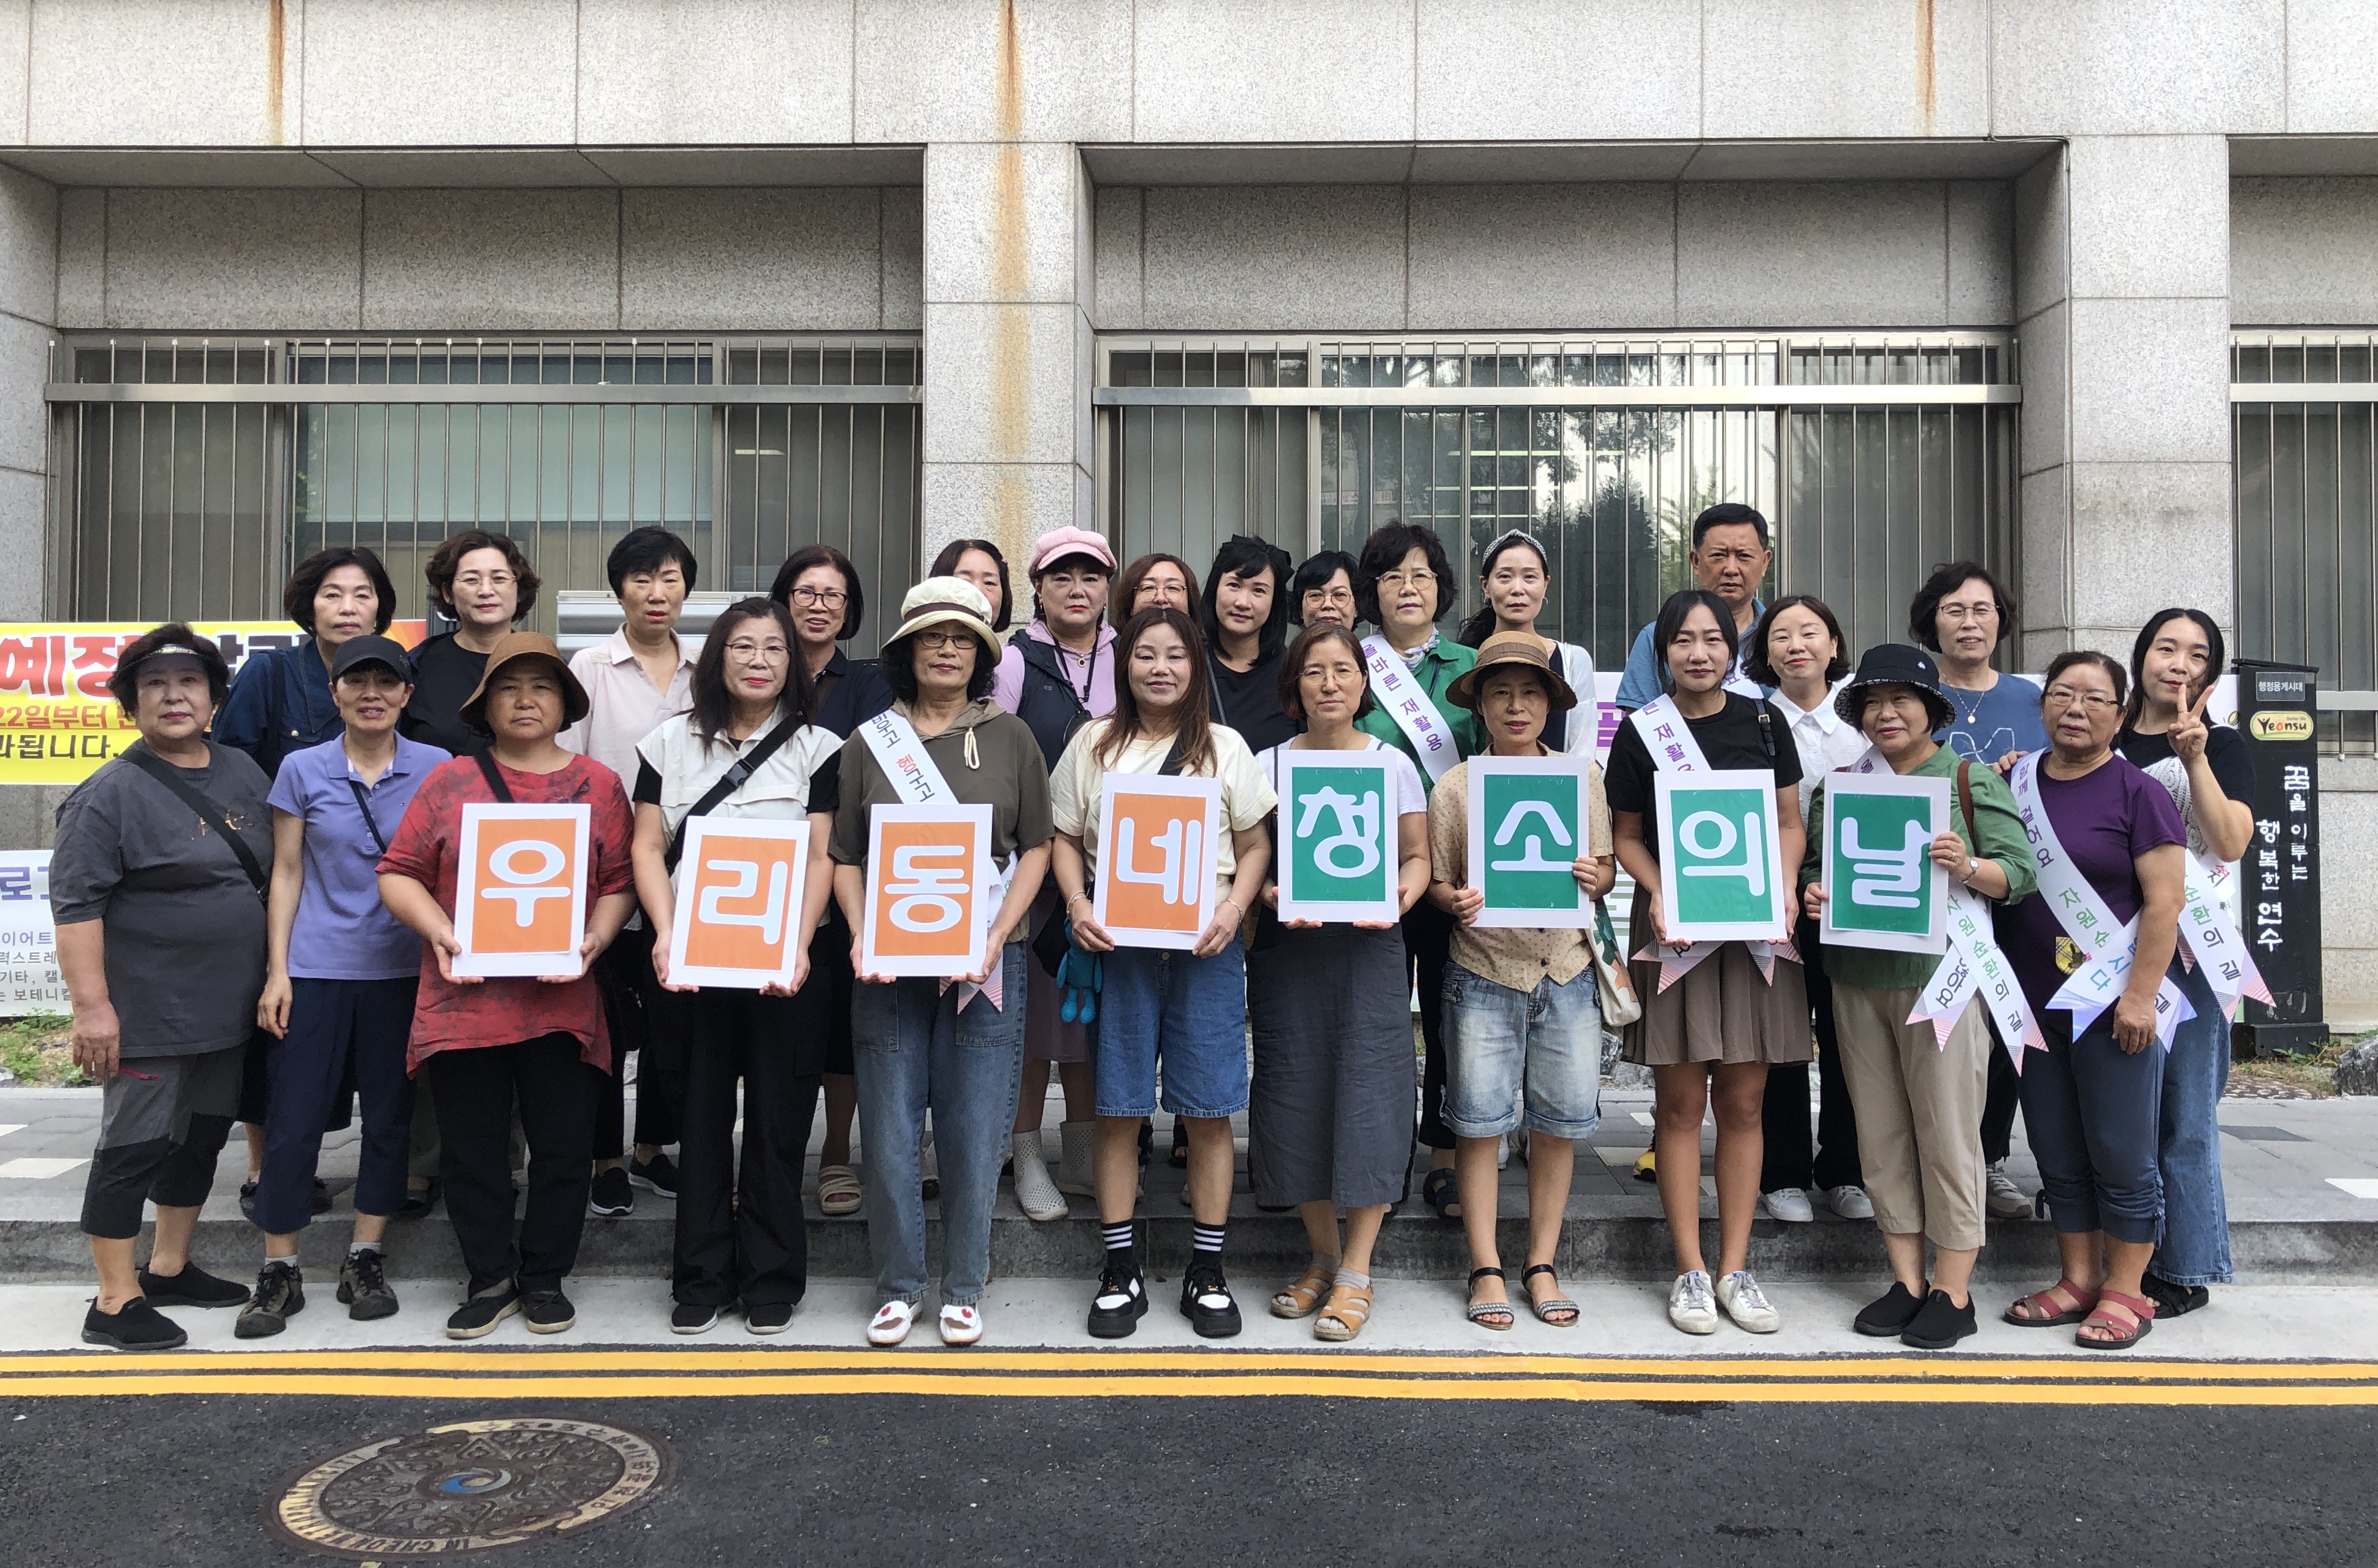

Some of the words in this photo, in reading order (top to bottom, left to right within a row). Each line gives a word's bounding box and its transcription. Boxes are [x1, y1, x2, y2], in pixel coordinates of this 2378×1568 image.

[1362, 644, 1402, 691] 올바른
[1400, 698, 1442, 751] 재활용
[2258, 681, 2303, 692] 행정용게시대
[2257, 717, 2307, 735] Yeonsu
[897, 754, 936, 802] 헹구고
[2017, 762, 2030, 797] 함께
[2284, 765, 2310, 812] 꿈을
[1117, 817, 1202, 905] 네
[1296, 786, 1381, 878] 청
[1491, 800, 1573, 871] 소
[1679, 811, 1765, 897] 의
[1841, 817, 1931, 908] 날
[2021, 805, 2054, 868] 걸어요
[2256, 819, 2280, 890] 행복한
[2291, 822, 2308, 881] 이루는
[481, 839, 571, 927] 우
[699, 860, 788, 945] 리
[884, 845, 970, 933] 동
[2, 931, 53, 946] 이어트
[2257, 902, 2284, 952] 연수
[45, 969, 66, 984] 캘
[2219, 960, 2241, 981] 길
[2007, 1010, 2024, 1033] 길
